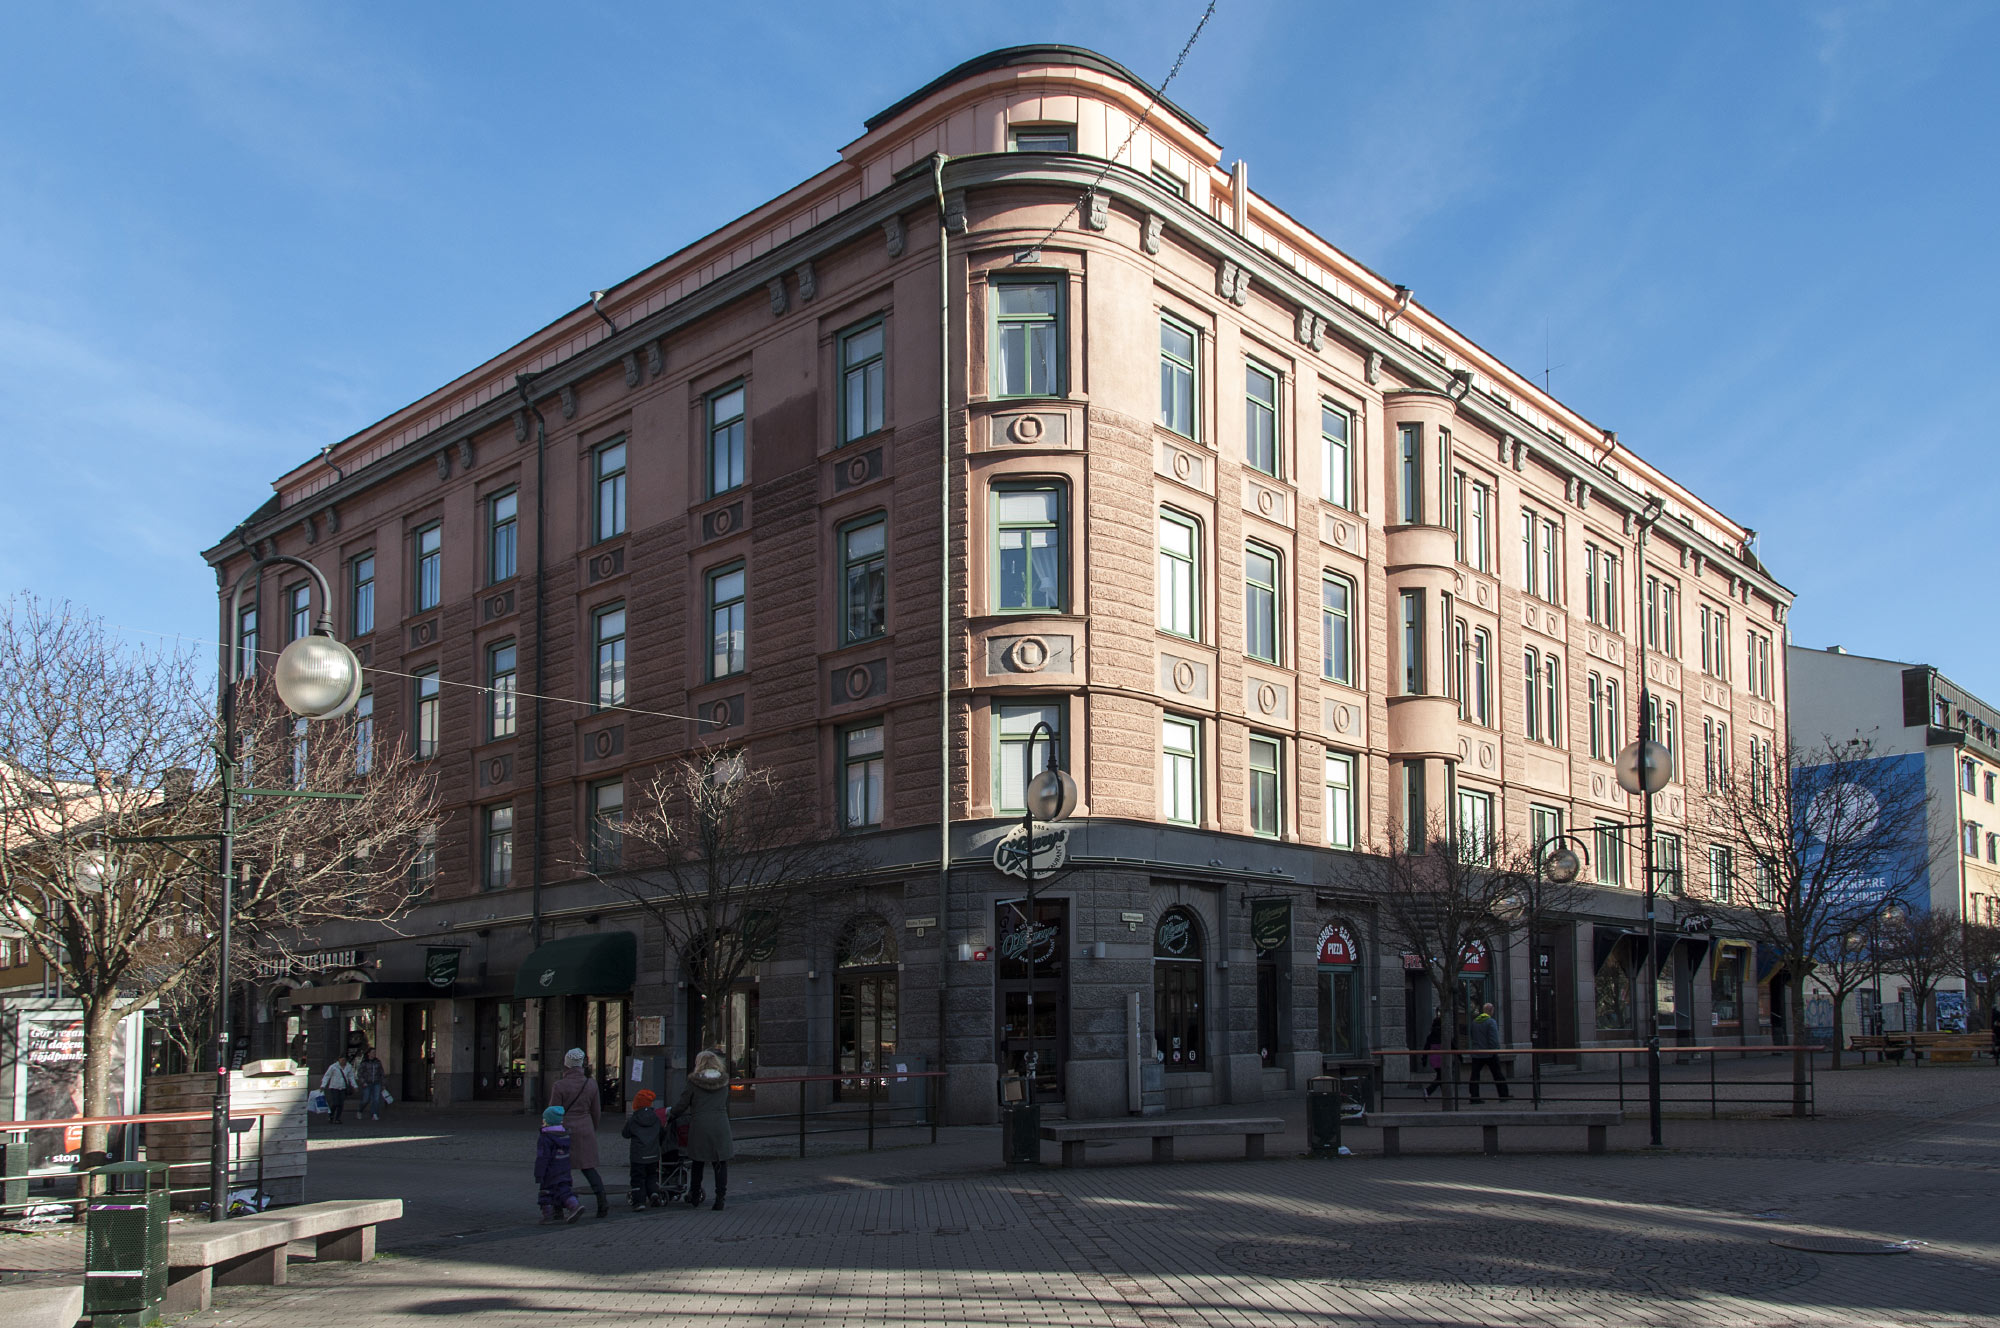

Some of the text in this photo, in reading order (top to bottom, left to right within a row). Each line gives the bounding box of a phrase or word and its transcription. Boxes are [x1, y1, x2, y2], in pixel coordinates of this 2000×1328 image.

[997, 830, 1068, 872] O'Larys
[1327, 942, 1344, 955] PIZZA
[30, 1027, 54, 1038] Gör
[30, 1039, 48, 1049] till
